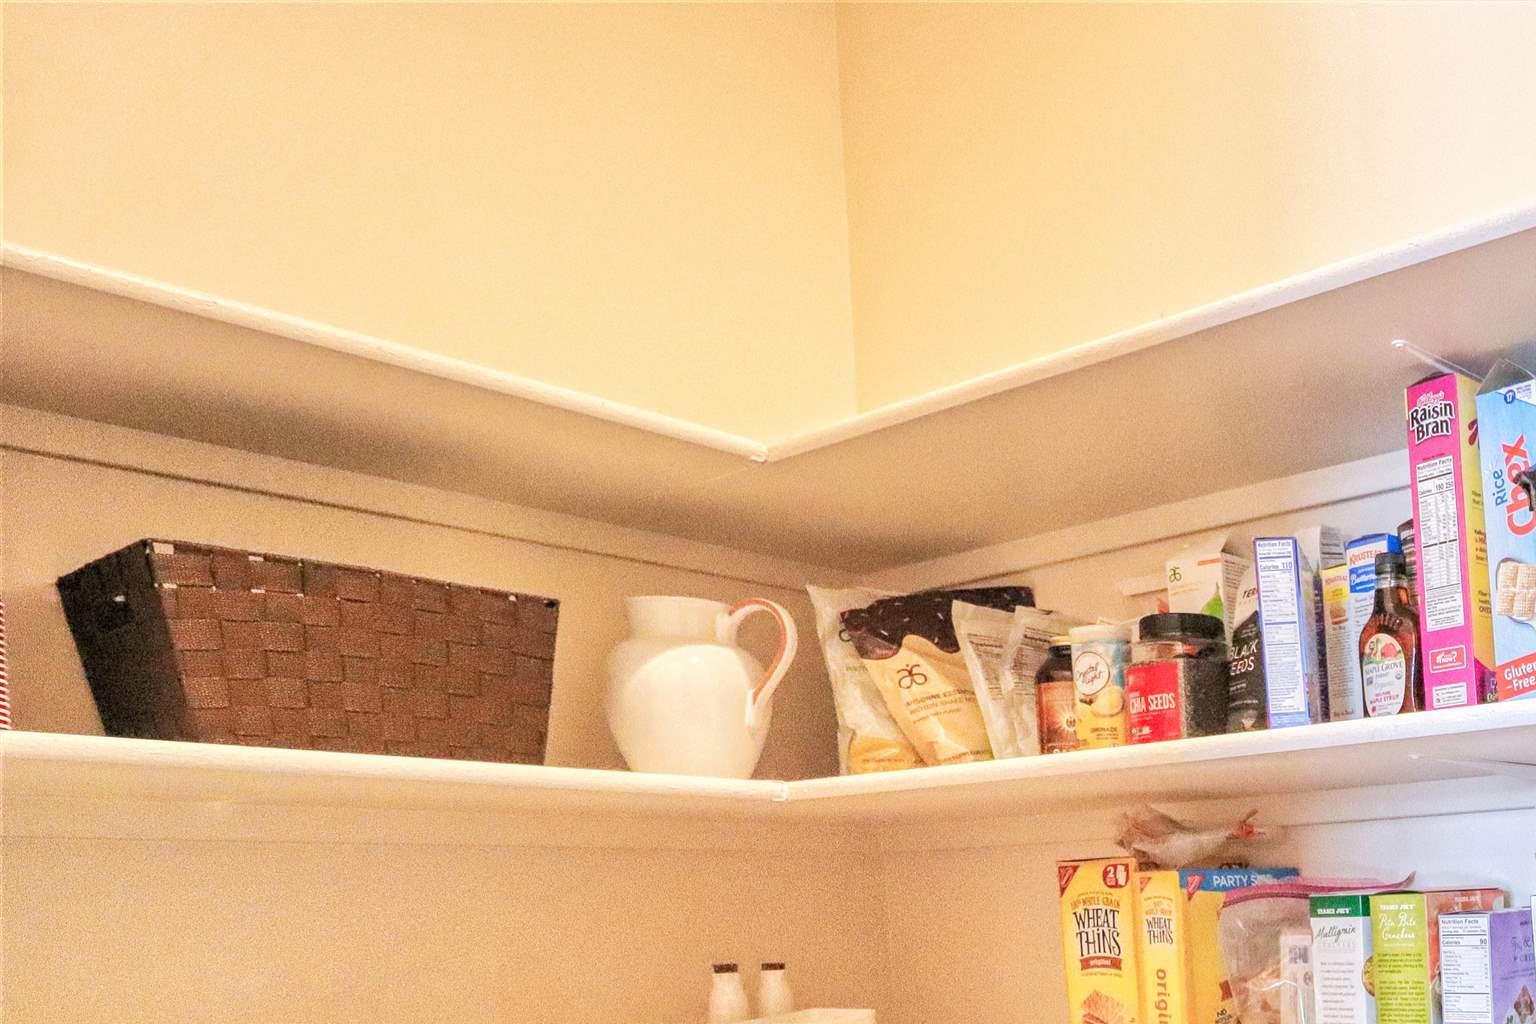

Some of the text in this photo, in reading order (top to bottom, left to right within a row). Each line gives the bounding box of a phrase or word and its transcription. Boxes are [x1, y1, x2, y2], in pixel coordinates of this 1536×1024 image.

[1409, 400, 1455, 431] Raisin
[1415, 418, 1452, 445] Bran
[1493, 468, 1509, 507] Rice
[1230, 656, 1255, 676] EEDS
[1512, 675, 1536, 692] Free
[1129, 692, 1176, 714] CHIA SEEDS
[1213, 875, 1249, 889] PARTY
[1072, 908, 1120, 930] WHEAT
[1146, 917, 1173, 930] WHEAT
[1479, 938, 1488, 946] 90
